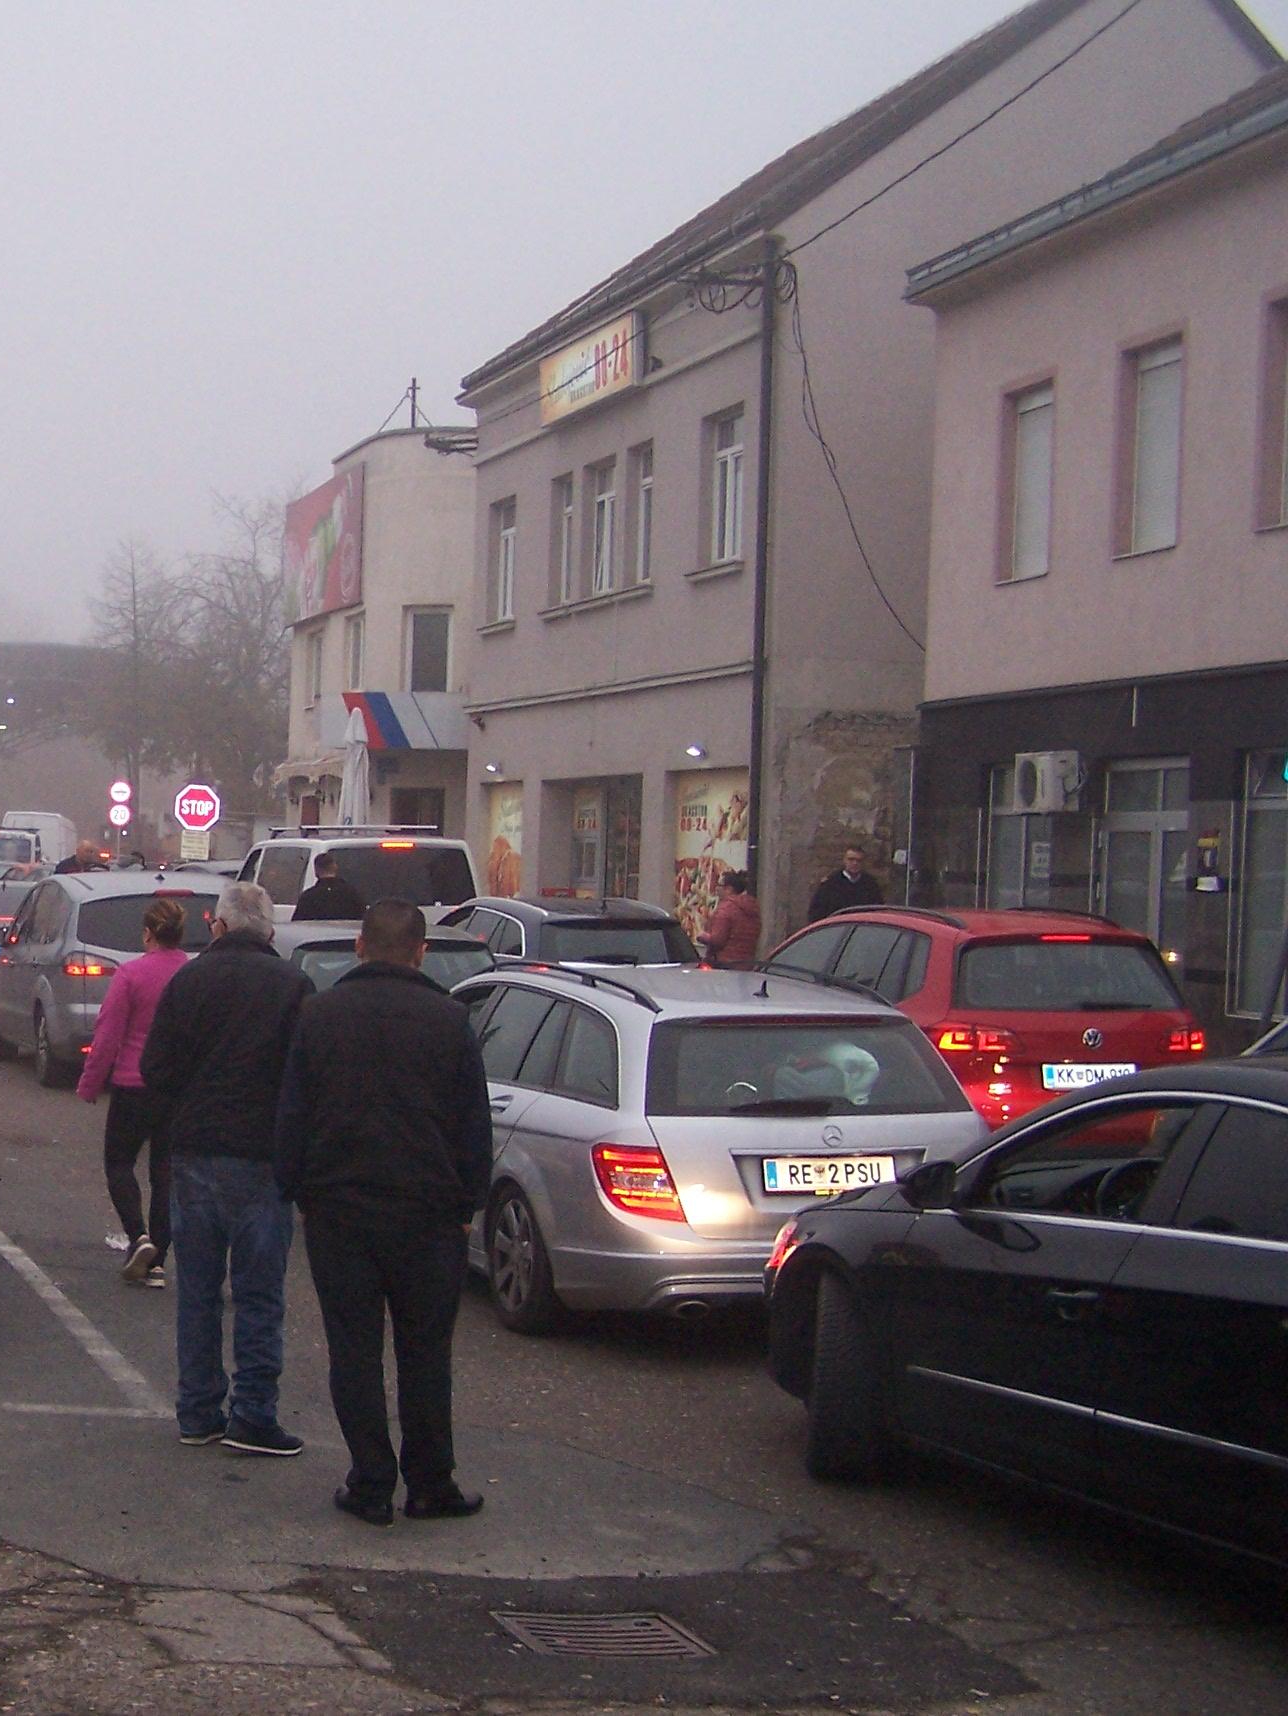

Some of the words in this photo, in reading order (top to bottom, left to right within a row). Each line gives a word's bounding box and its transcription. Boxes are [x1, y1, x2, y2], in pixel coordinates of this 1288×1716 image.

[180, 798, 214, 817] STOP
[1056, 1068, 1075, 1083] KK
[788, 1163, 813, 1185] RE
